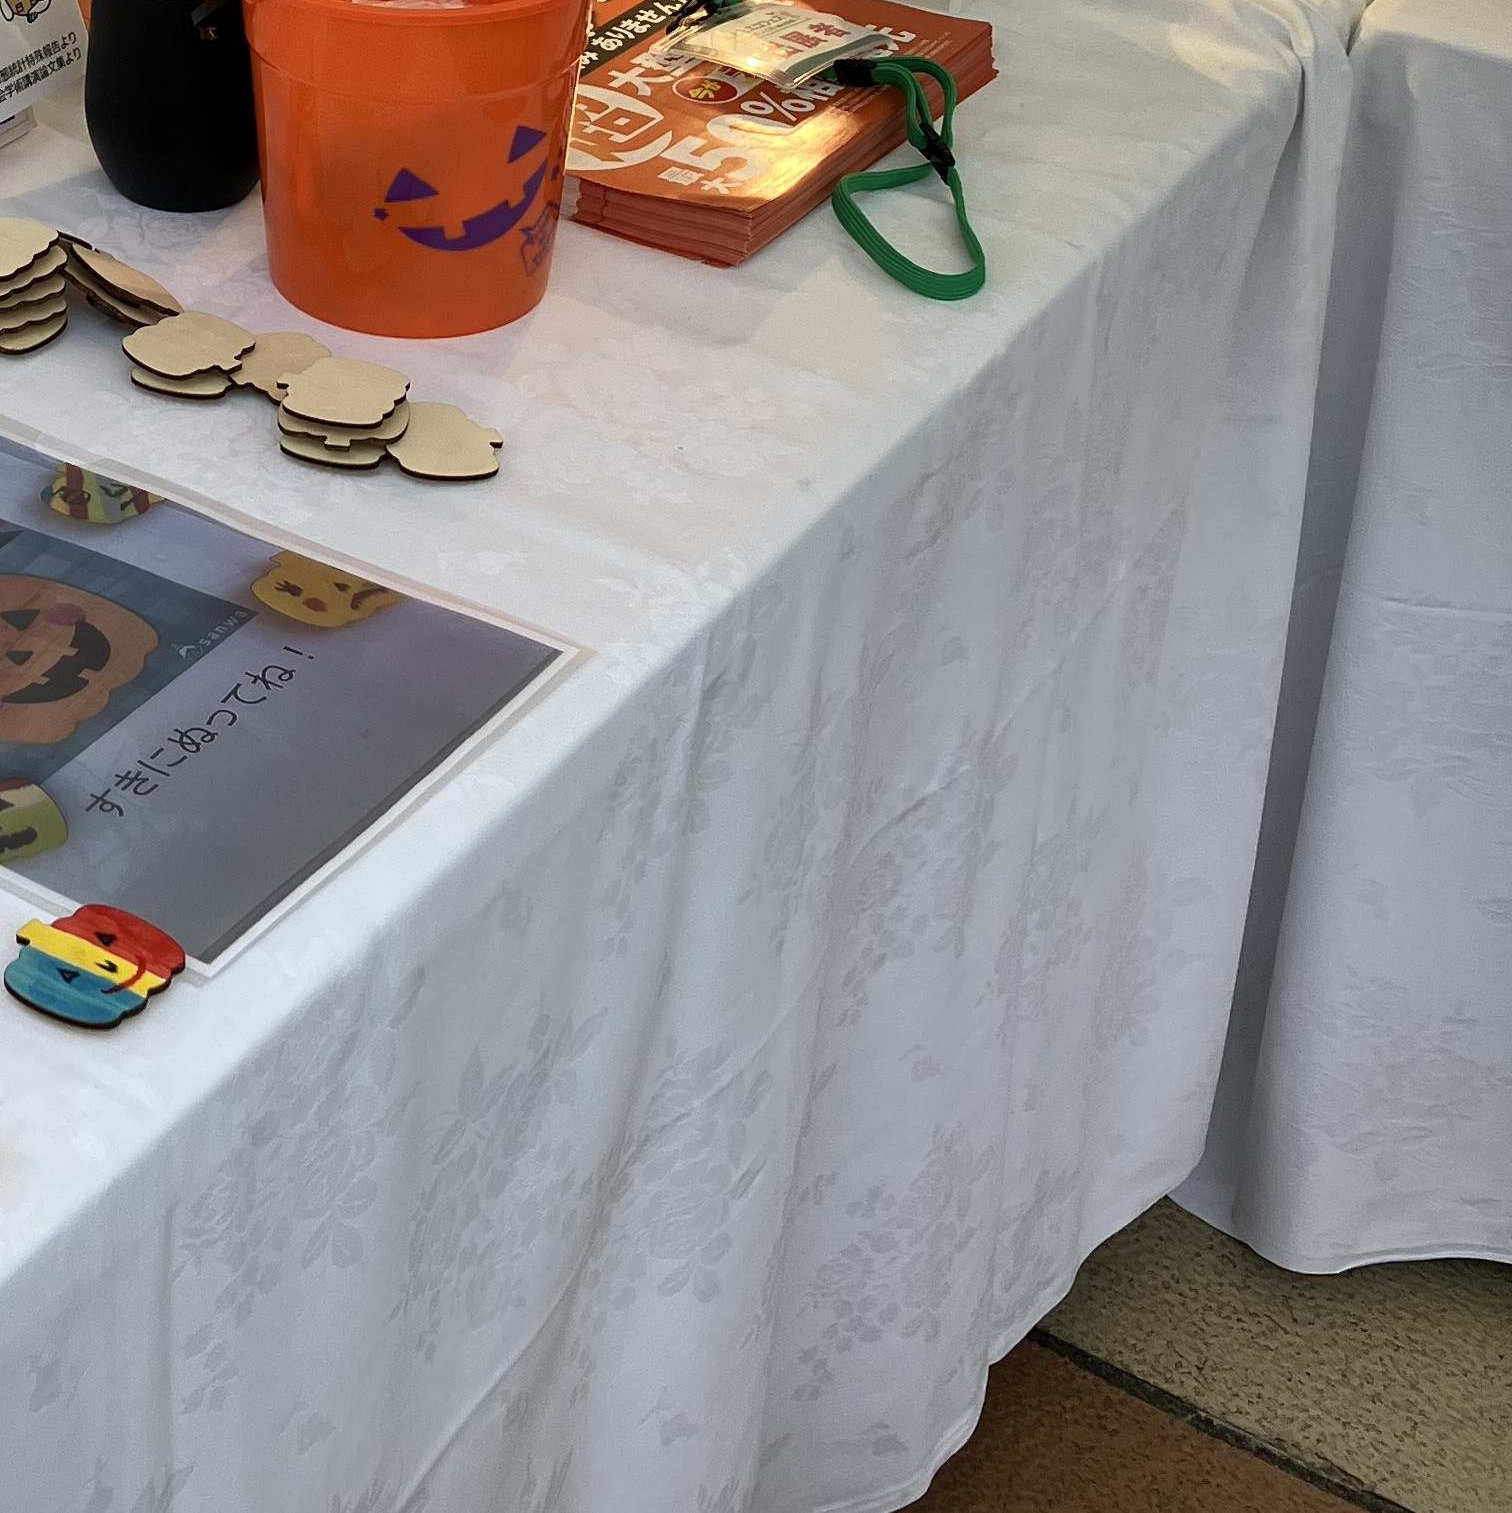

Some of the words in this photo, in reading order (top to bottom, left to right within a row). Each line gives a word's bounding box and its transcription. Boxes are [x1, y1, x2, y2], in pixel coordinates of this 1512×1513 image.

[199, 610, 249, 646] sanwa
[85, 645, 315, 817] すきにぬってね!
